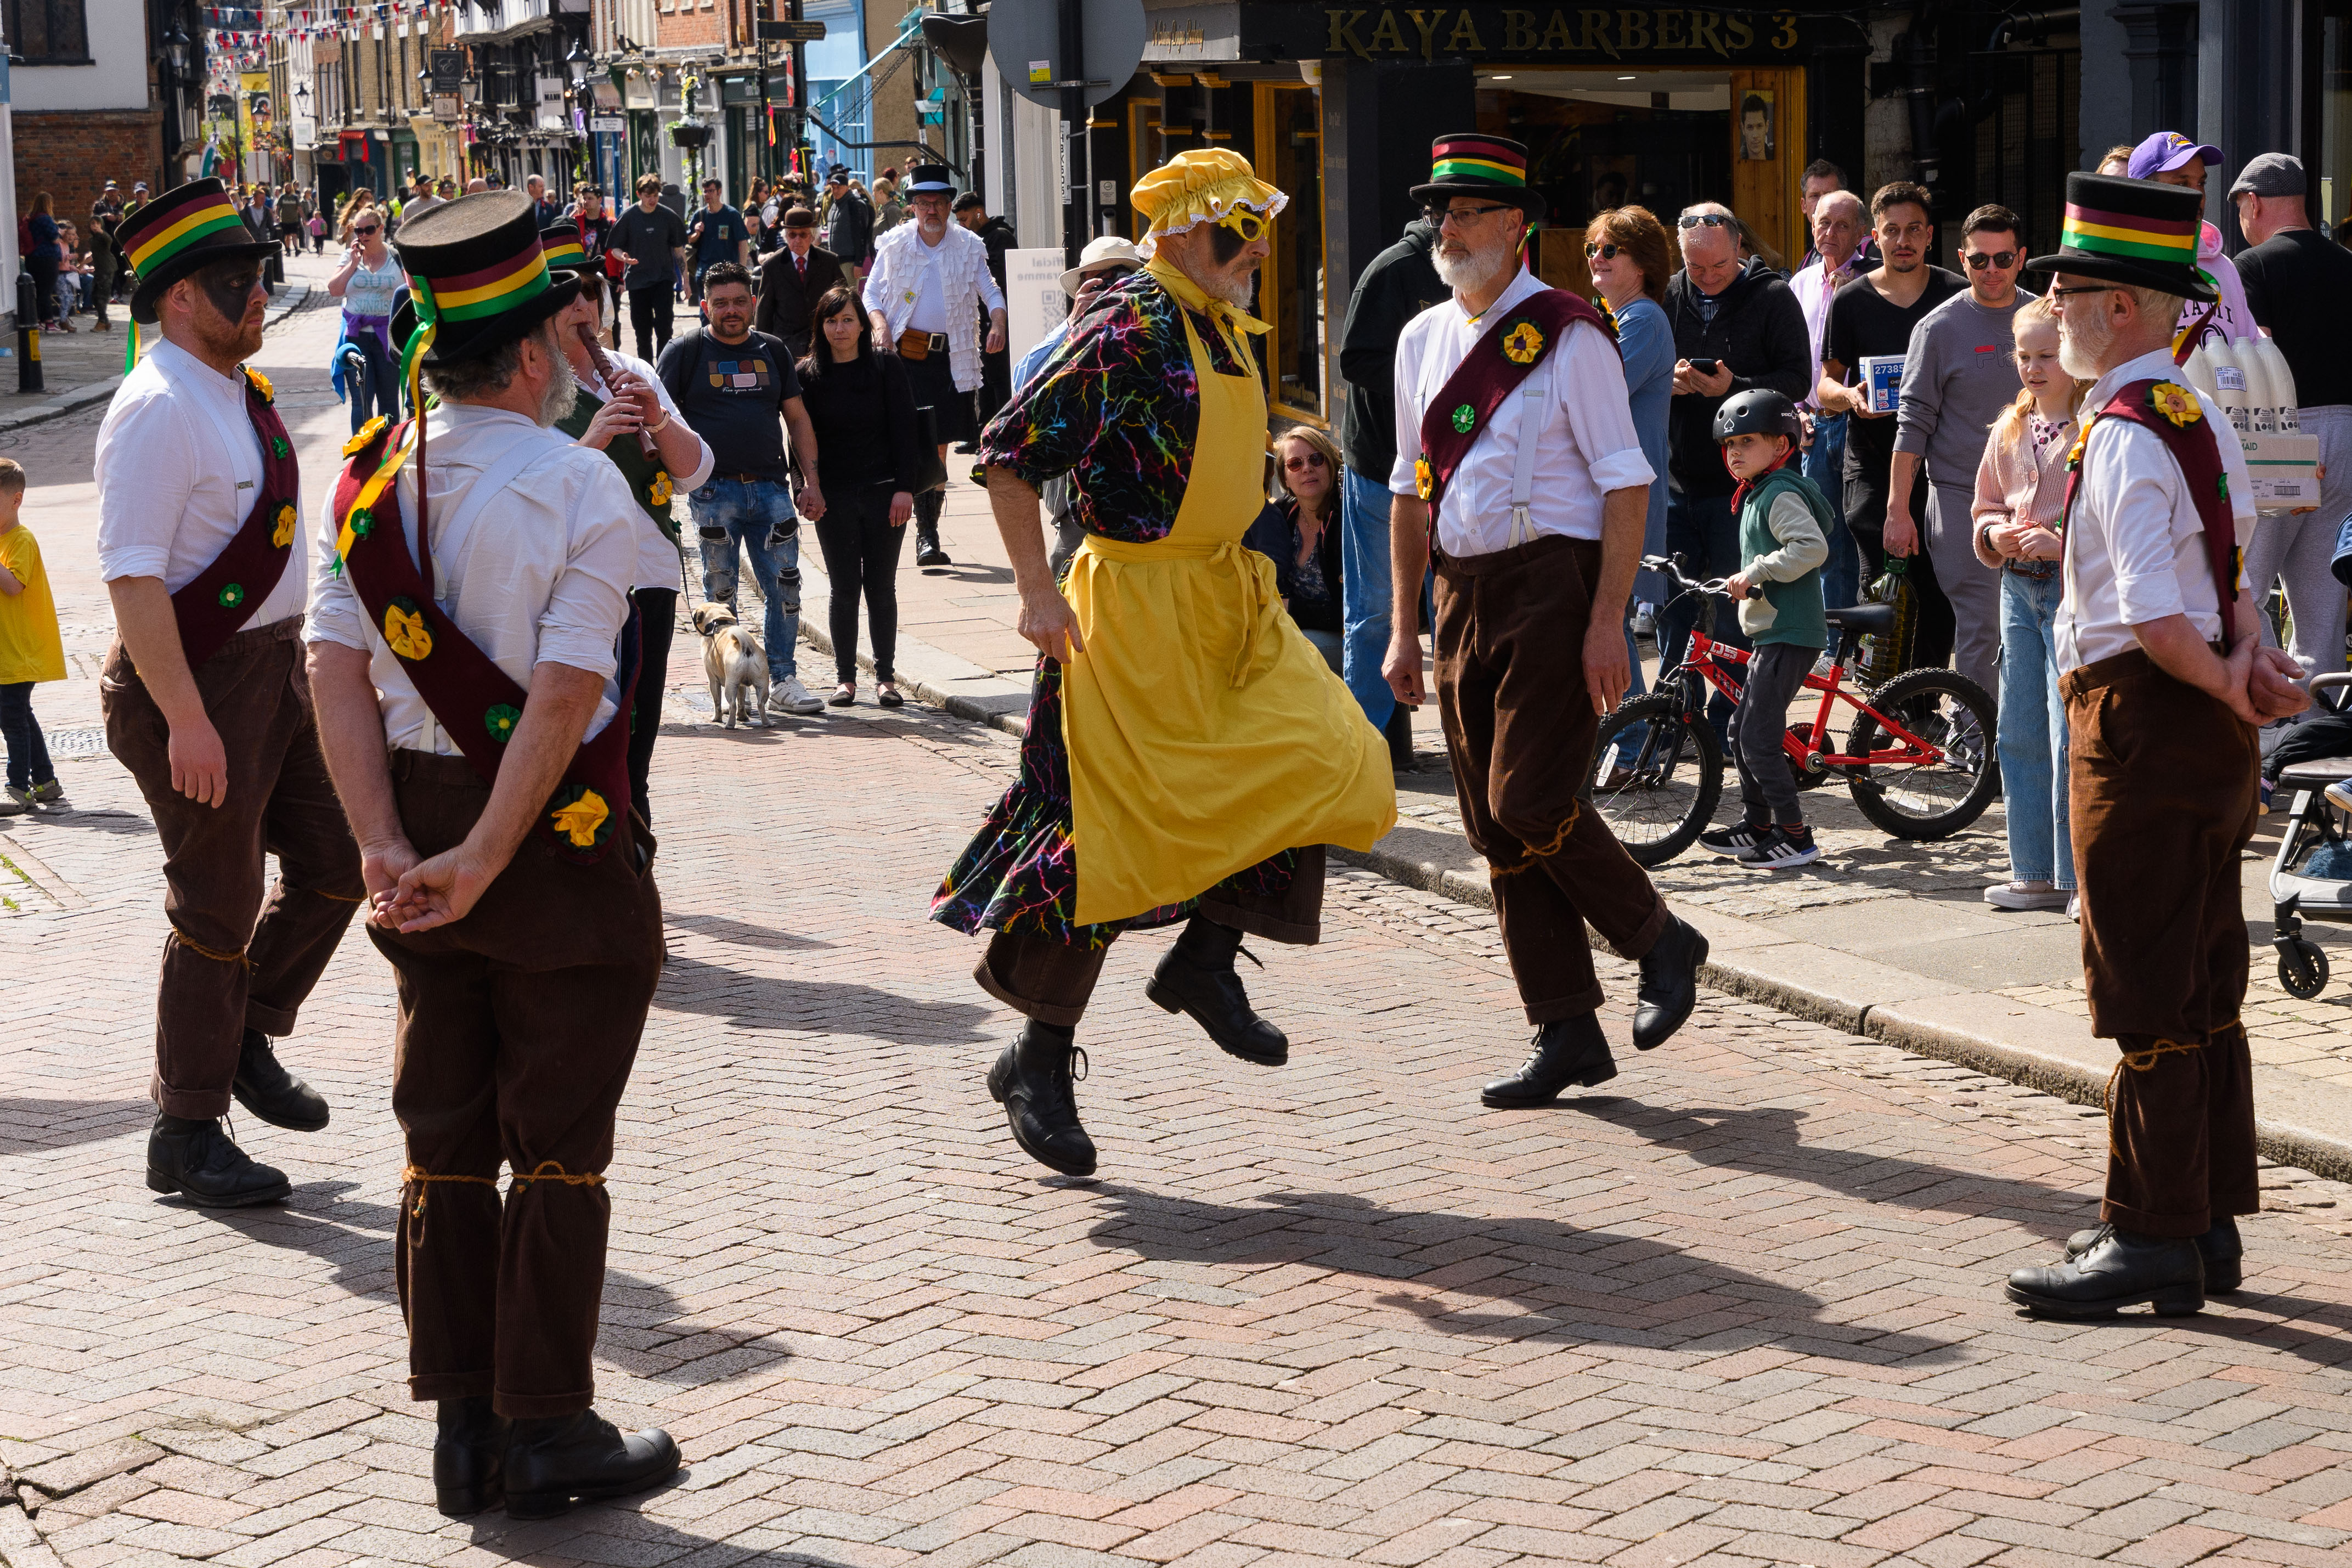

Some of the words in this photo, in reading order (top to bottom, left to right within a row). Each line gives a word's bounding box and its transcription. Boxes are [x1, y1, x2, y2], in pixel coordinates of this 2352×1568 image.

[1324, 9, 1486, 63] KAYA
[1502, 9, 1754, 60] BARBERS
[1771, 9, 1798, 50] 3
[352, 274, 395, 290] OUT
